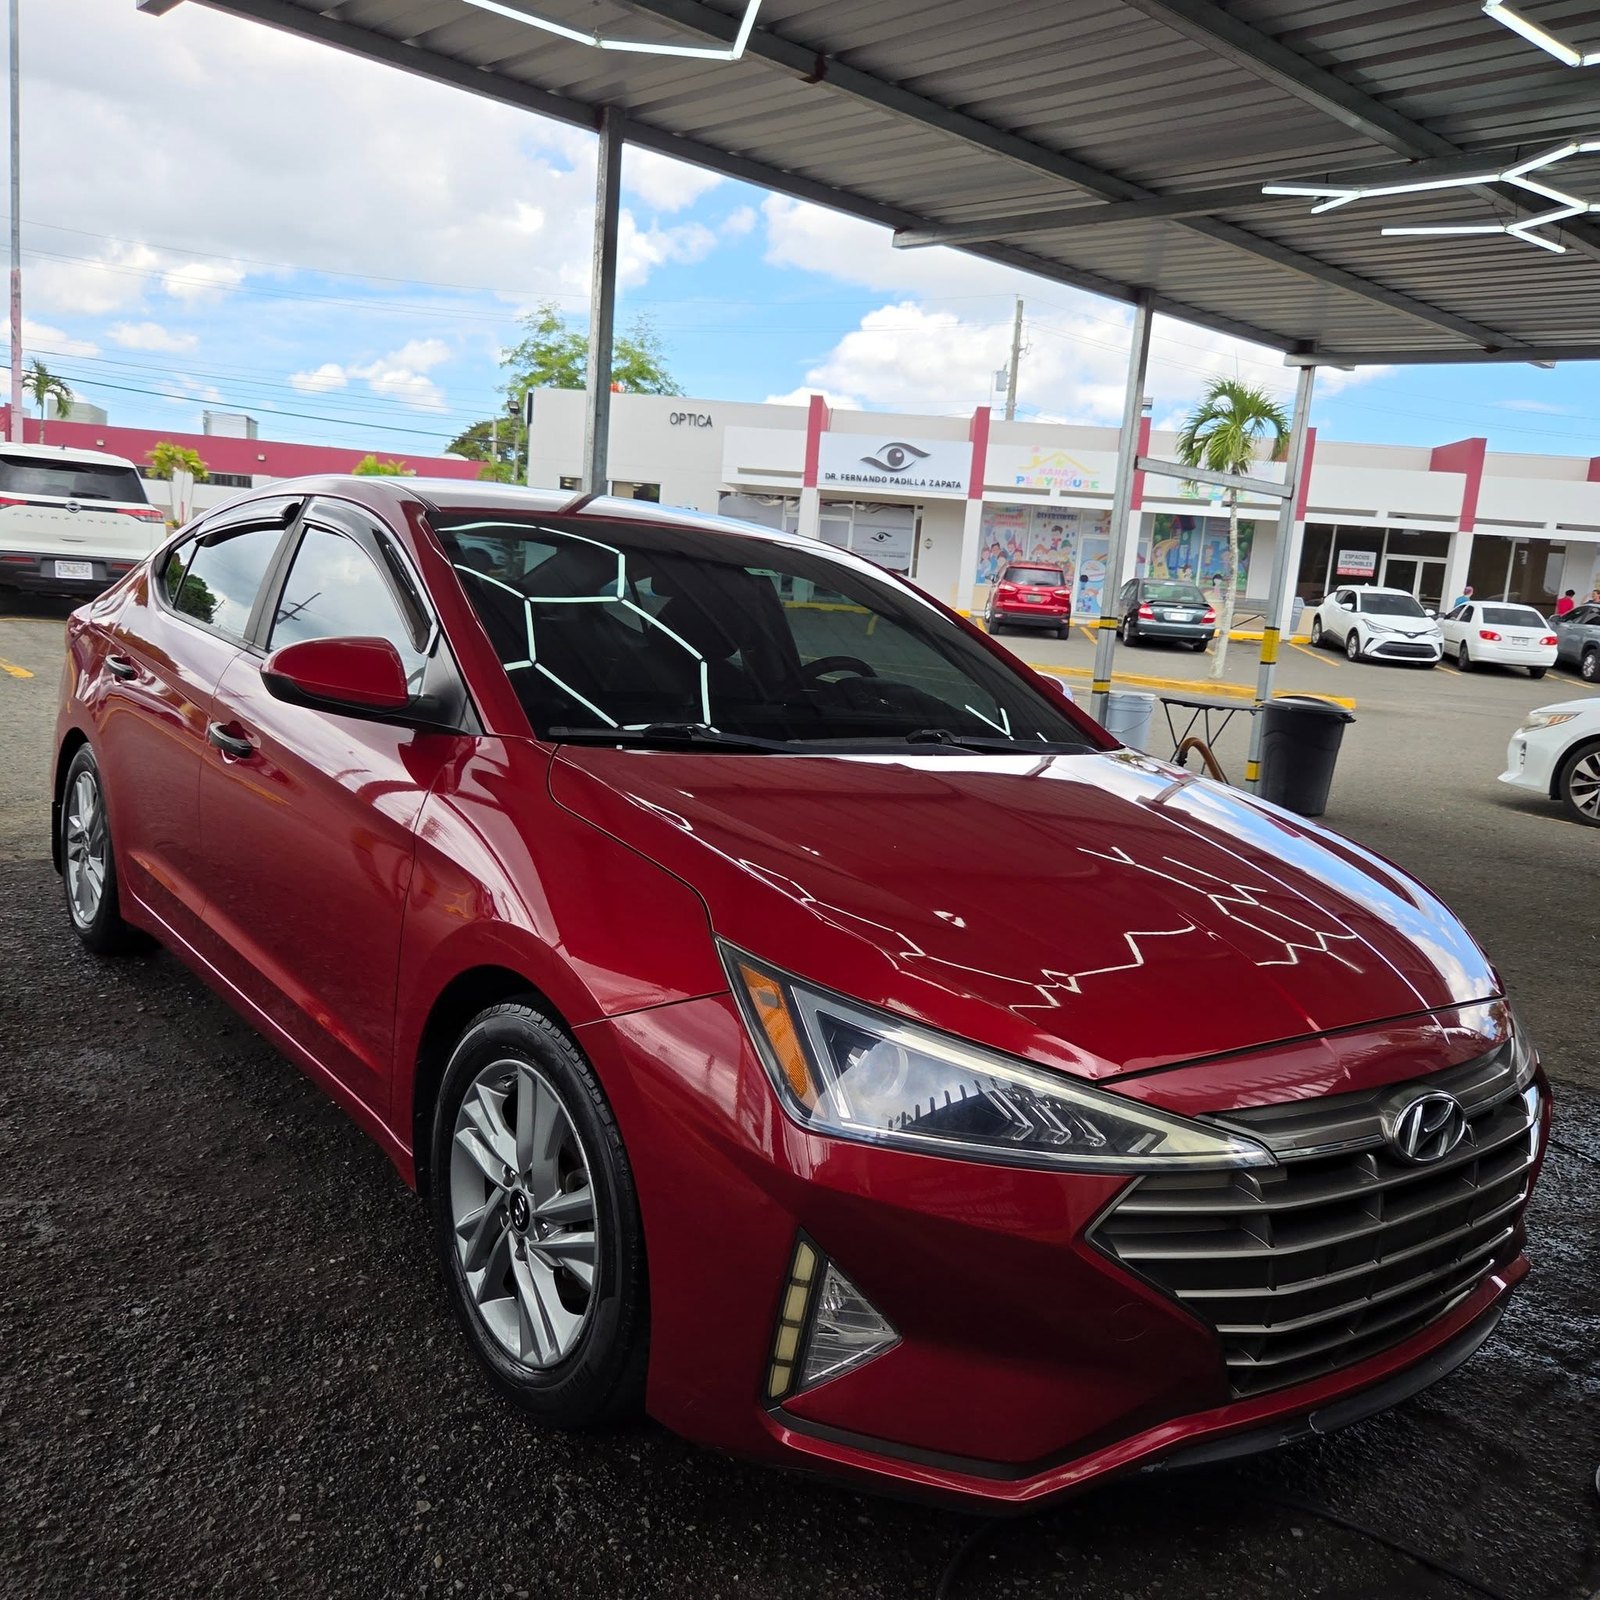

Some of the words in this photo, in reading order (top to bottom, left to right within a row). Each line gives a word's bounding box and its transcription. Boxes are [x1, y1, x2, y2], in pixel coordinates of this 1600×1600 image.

[669, 412, 713, 428] OPTICA
[825, 472, 838, 481] DR.
[840, 473, 888, 484] FERNANDO
[889, 477, 926, 487] PADILLA
[928, 480, 962, 489] ZAPATA
[1015, 475, 1099, 489] PLAYHOUSE
[1344, 553, 1370, 561] ESPACIOS
